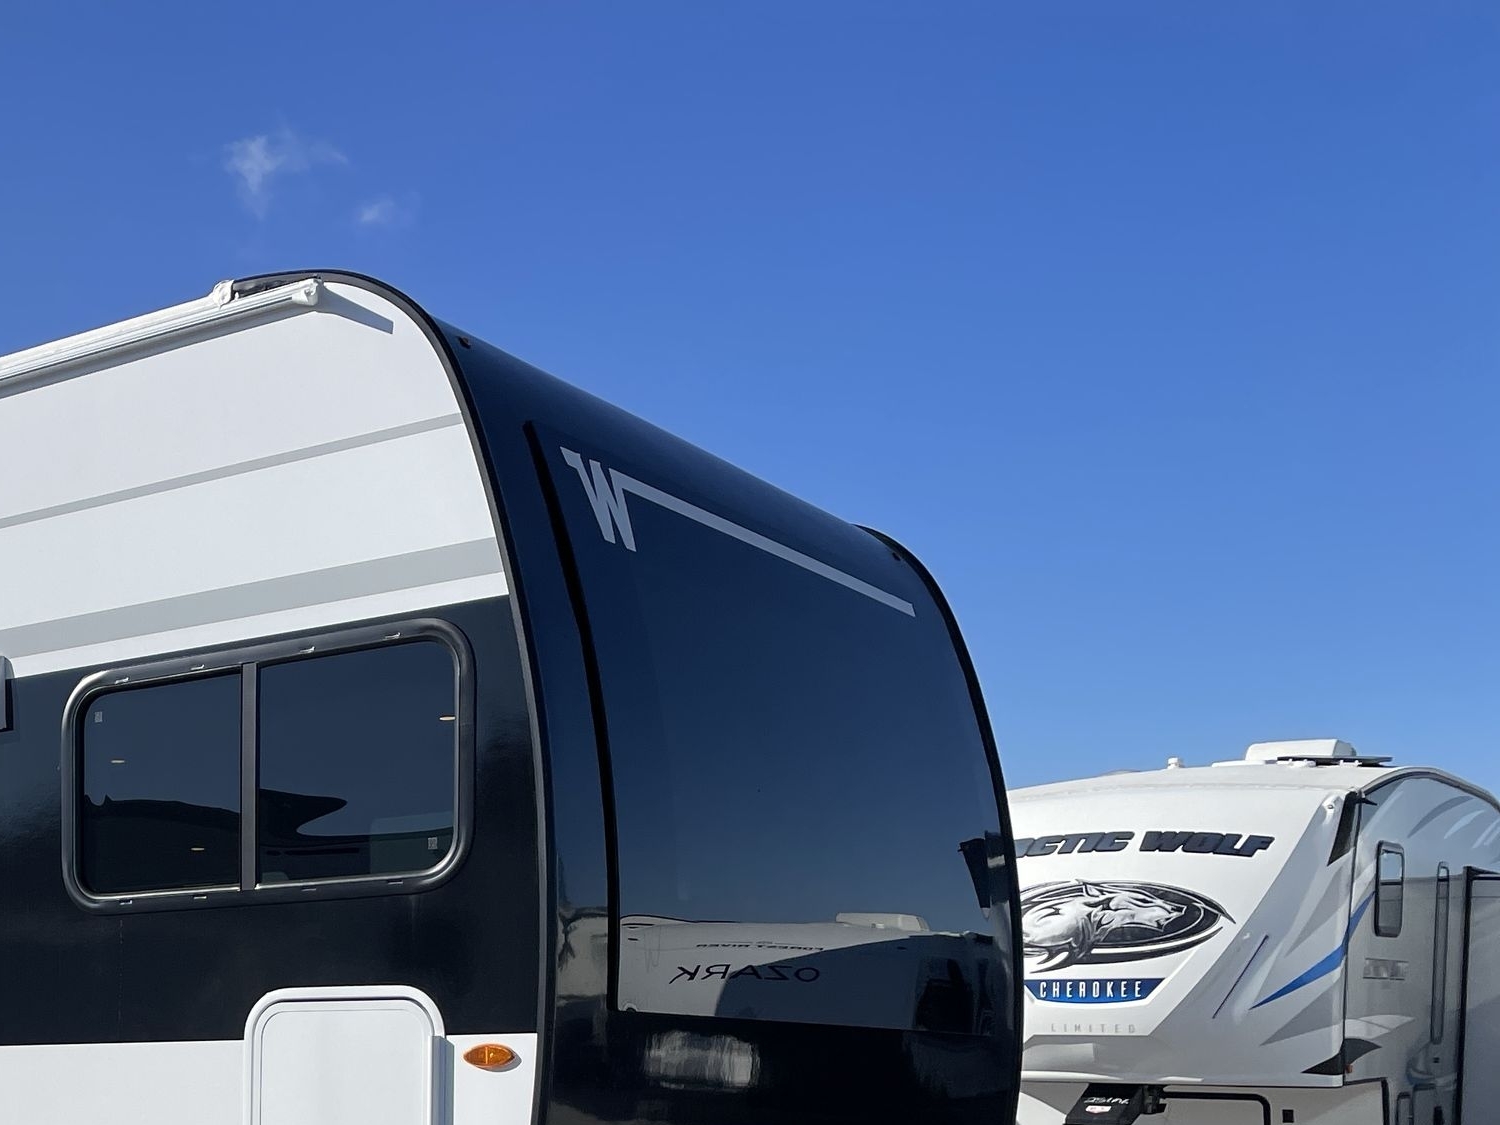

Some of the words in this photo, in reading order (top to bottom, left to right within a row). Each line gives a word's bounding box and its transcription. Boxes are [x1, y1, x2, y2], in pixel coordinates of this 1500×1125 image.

[1139, 831, 1275, 858] WOLF
[1040, 980, 1142, 998] CHEROKEE
[1050, 1023, 1136, 1034] LIMITED
